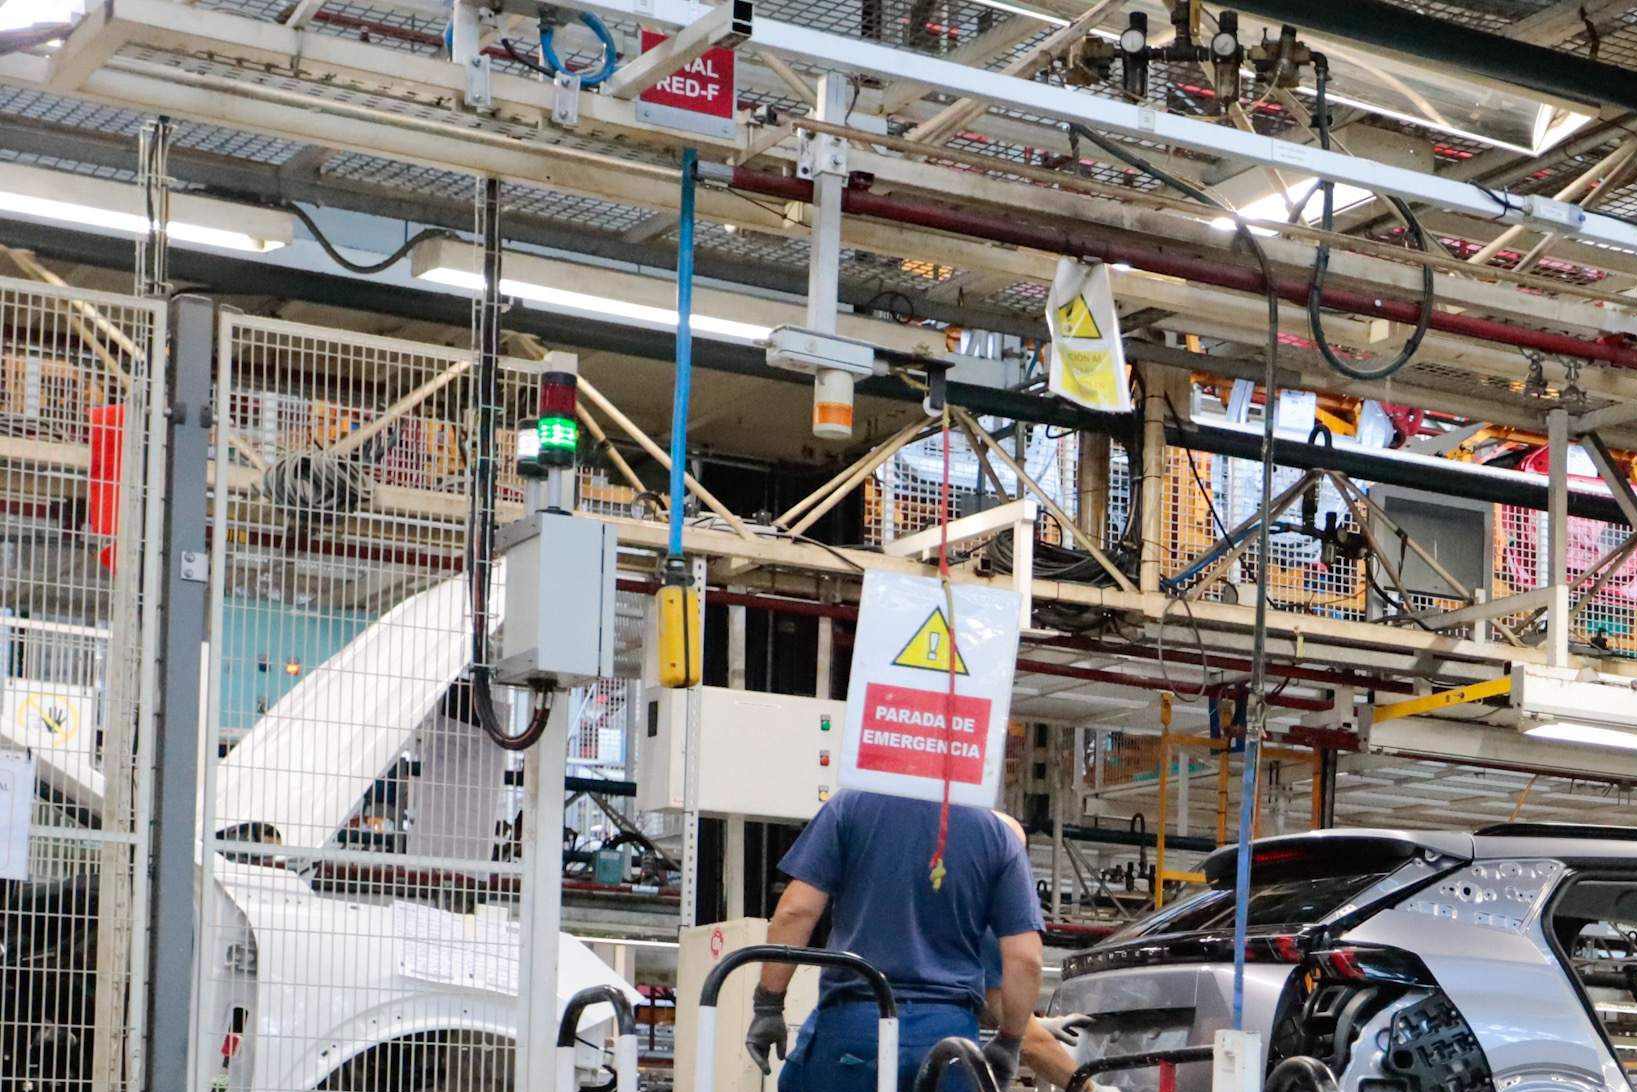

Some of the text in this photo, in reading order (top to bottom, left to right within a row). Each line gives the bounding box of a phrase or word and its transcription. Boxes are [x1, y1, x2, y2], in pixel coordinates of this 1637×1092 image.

[875, 705, 977, 733] PARADA DE
[862, 729, 981, 759] EMERGENCIA
